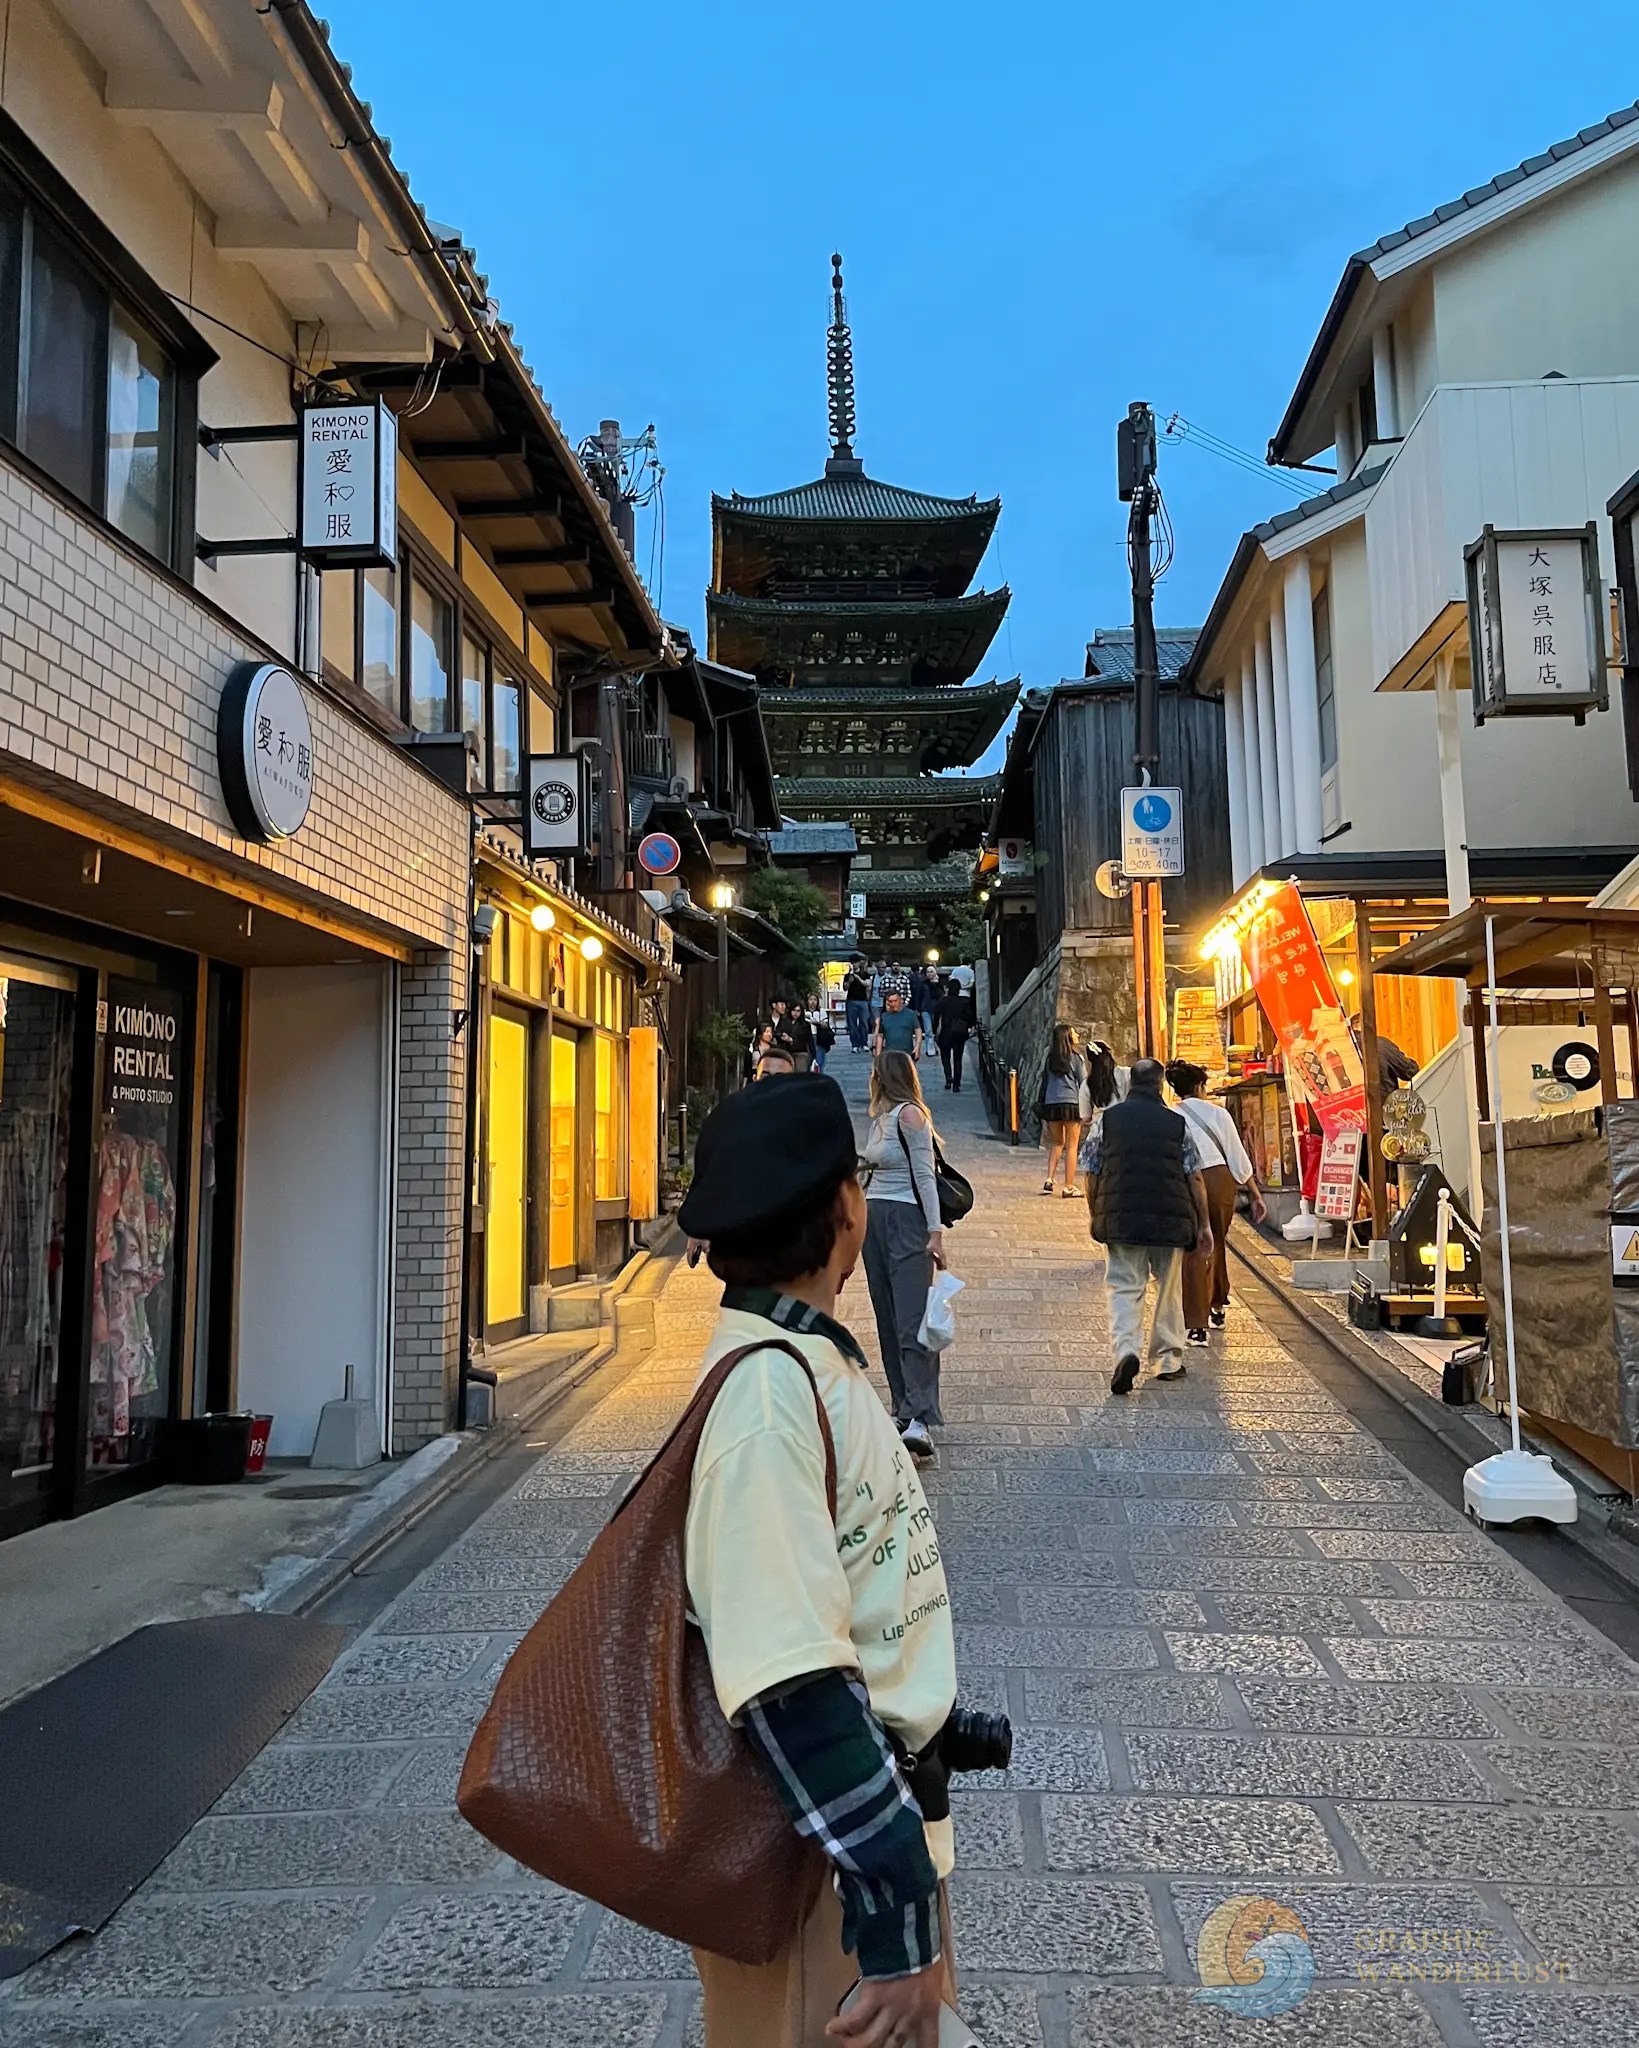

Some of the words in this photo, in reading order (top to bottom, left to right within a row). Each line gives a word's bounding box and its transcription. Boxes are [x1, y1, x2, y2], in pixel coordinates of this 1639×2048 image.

[311, 415, 369, 428] KIMONO
[311, 429, 369, 442] RENTAL
[324, 448, 354, 539] 愛和服
[257, 715, 310, 782] 愛和服
[1156, 860, 1178, 869] 40m
[115, 1005, 176, 1042] KIMONO
[113, 1046, 174, 1080] RENTAL
[112, 1086, 118, 1099] &
[120, 1086, 146, 1101] PHOTO
[147, 1089, 173, 1104] STUDIO
[837, 1525, 867, 1553] AS
[882, 1492, 909, 1526] THE
[872, 1537, 897, 1567] OF
